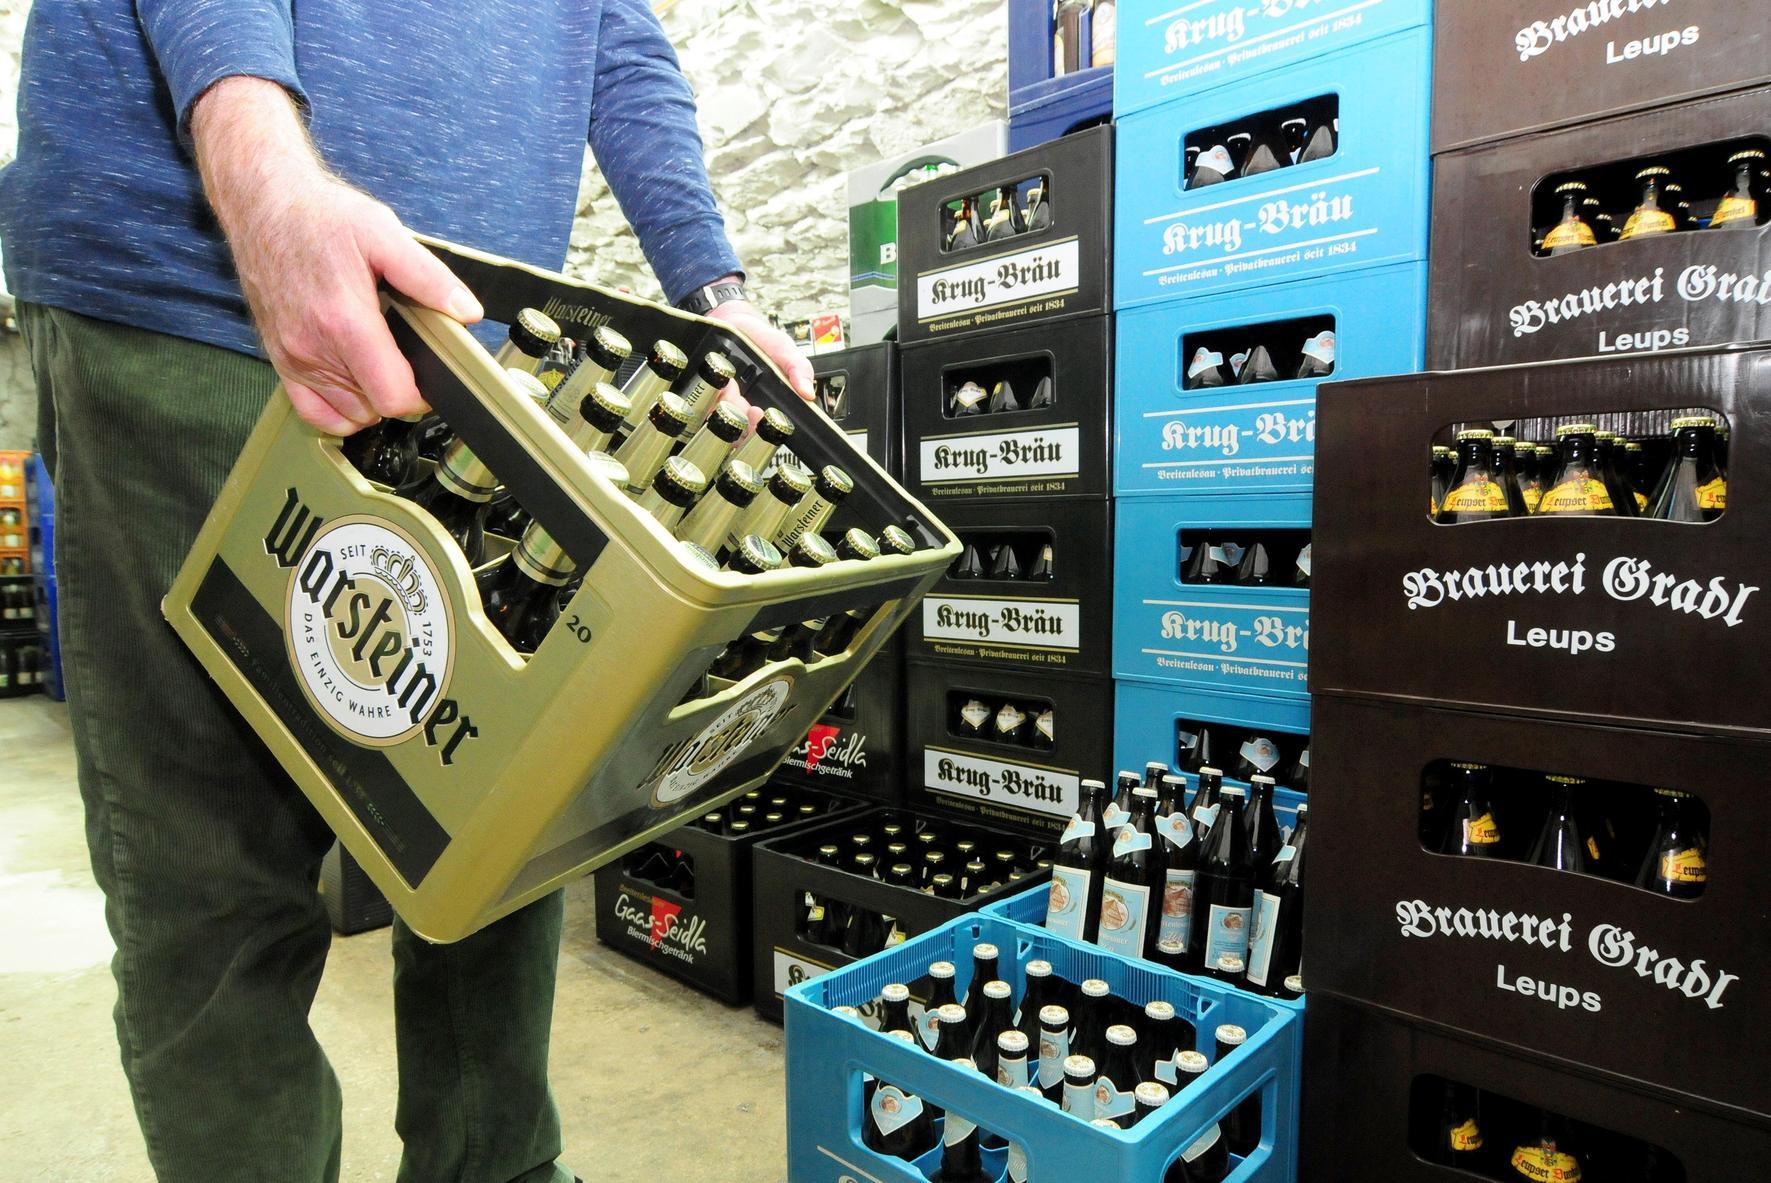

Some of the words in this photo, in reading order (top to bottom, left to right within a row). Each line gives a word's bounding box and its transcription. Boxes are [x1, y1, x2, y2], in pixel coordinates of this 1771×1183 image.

[1606, 25, 1700, 64] Leups
[1163, 191, 1354, 256] Krug-Bräu
[1304, 247, 1324, 260] seit
[1328, 240, 1358, 257] 1834
[932, 256, 1062, 304] Krug-Bräu
[1045, 298, 1065, 311] 1834
[1509, 267, 1664, 337] Brauerei
[1677, 264, 1771, 305] Grad
[1598, 327, 1691, 353] Leups
[934, 437, 1063, 474] Krug-Bräu
[1157, 469, 1216, 480] Breitenlesau
[1222, 465, 1297, 479] Privatbrauerei
[1046, 482, 1066, 491] 1834
[782, 500, 825, 548] Warsteiner
[339, 544, 368, 561] SEIT
[1403, 553, 1585, 610] Brauerei
[1602, 556, 1760, 627] Gradl
[262, 487, 479, 767] Warsteiner
[565, 614, 593, 644] 20
[936, 604, 1063, 637] Krug-Bräu
[1507, 620, 1615, 654] Leups
[420, 621, 435, 657] 1753
[304, 613, 315, 643] DAS
[310, 652, 344, 702] EINZIG
[349, 699, 392, 719] WAHRE
[1047, 654, 1066, 664] 1834
[1220, 663, 1294, 680] Privatbrauerei
[937, 758, 1063, 804] Krug-Bräu
[1395, 899, 1572, 952] Brauerei
[1588, 923, 1739, 1010] Gradl
[1497, 964, 1601, 1012] Leups
